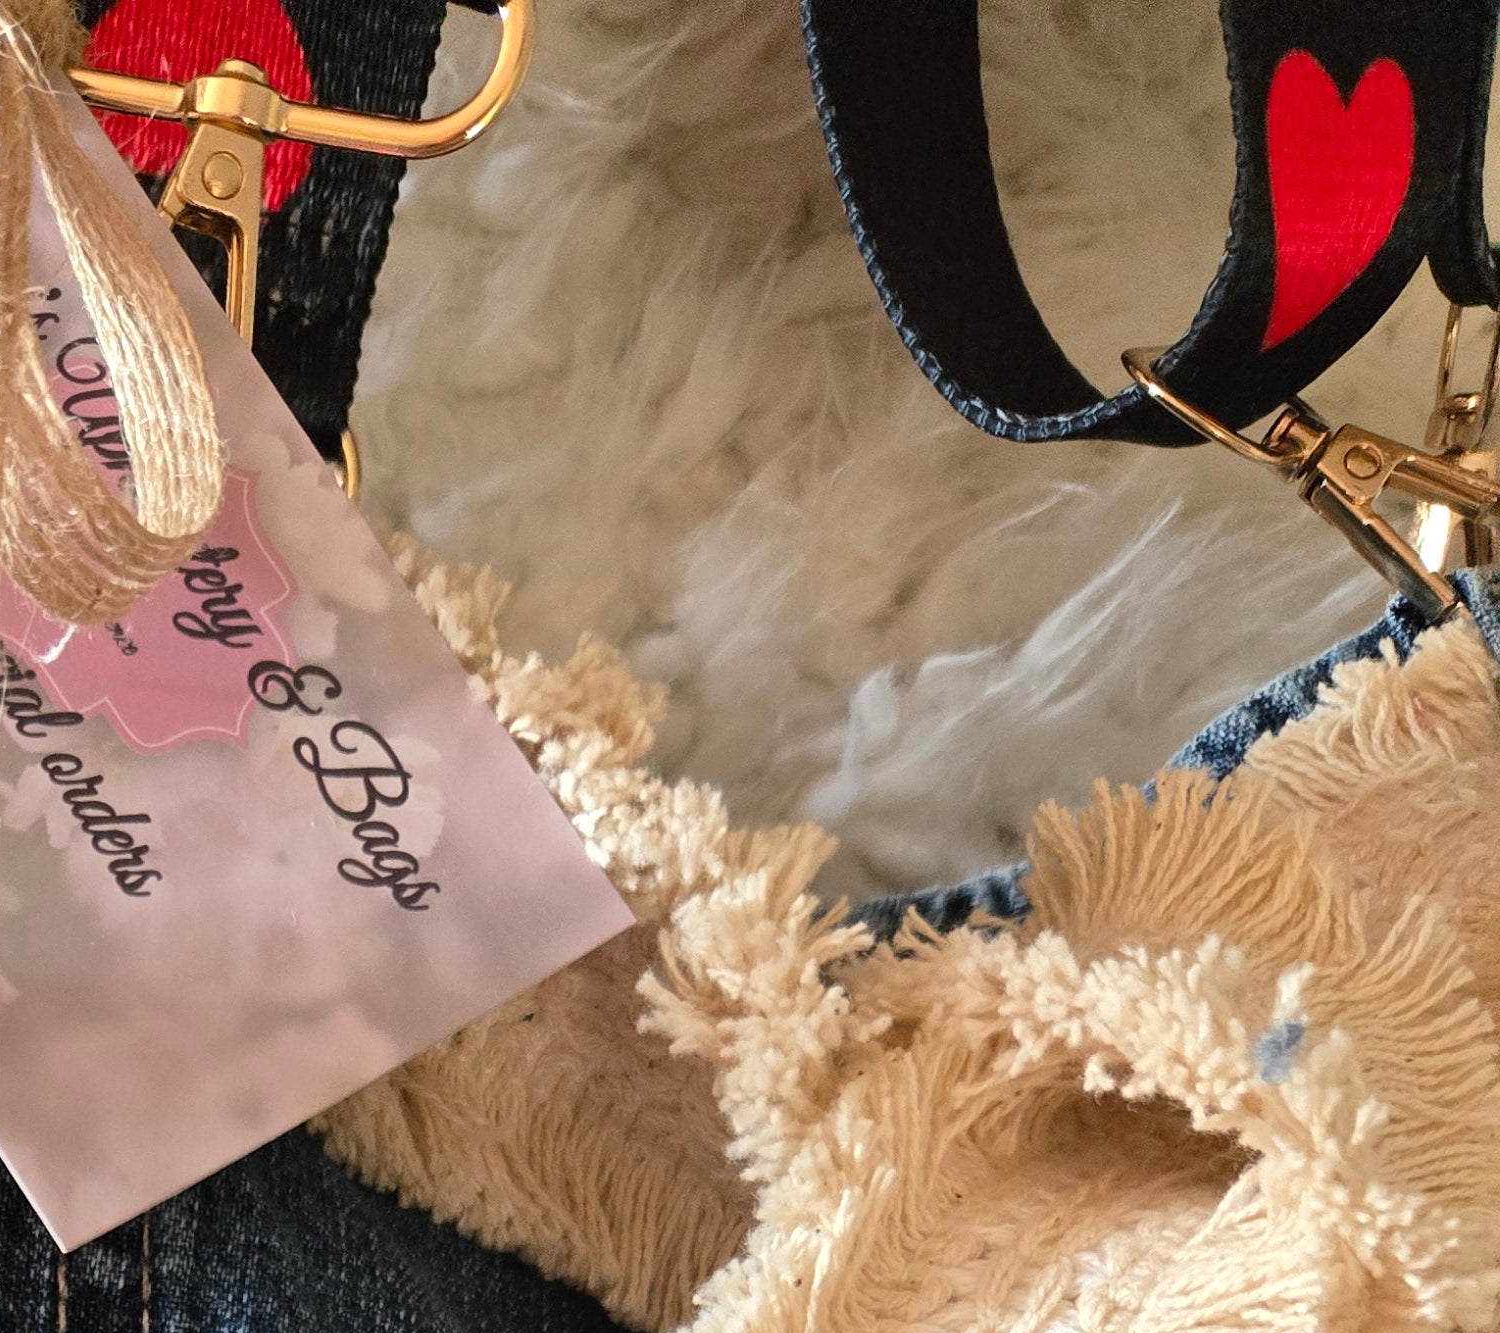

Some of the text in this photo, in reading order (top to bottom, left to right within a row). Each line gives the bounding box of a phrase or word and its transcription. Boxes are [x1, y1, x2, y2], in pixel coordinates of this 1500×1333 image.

[247, 659, 343, 716] &
[40, 752, 162, 898] orders
[292, 720, 441, 911] Bags
